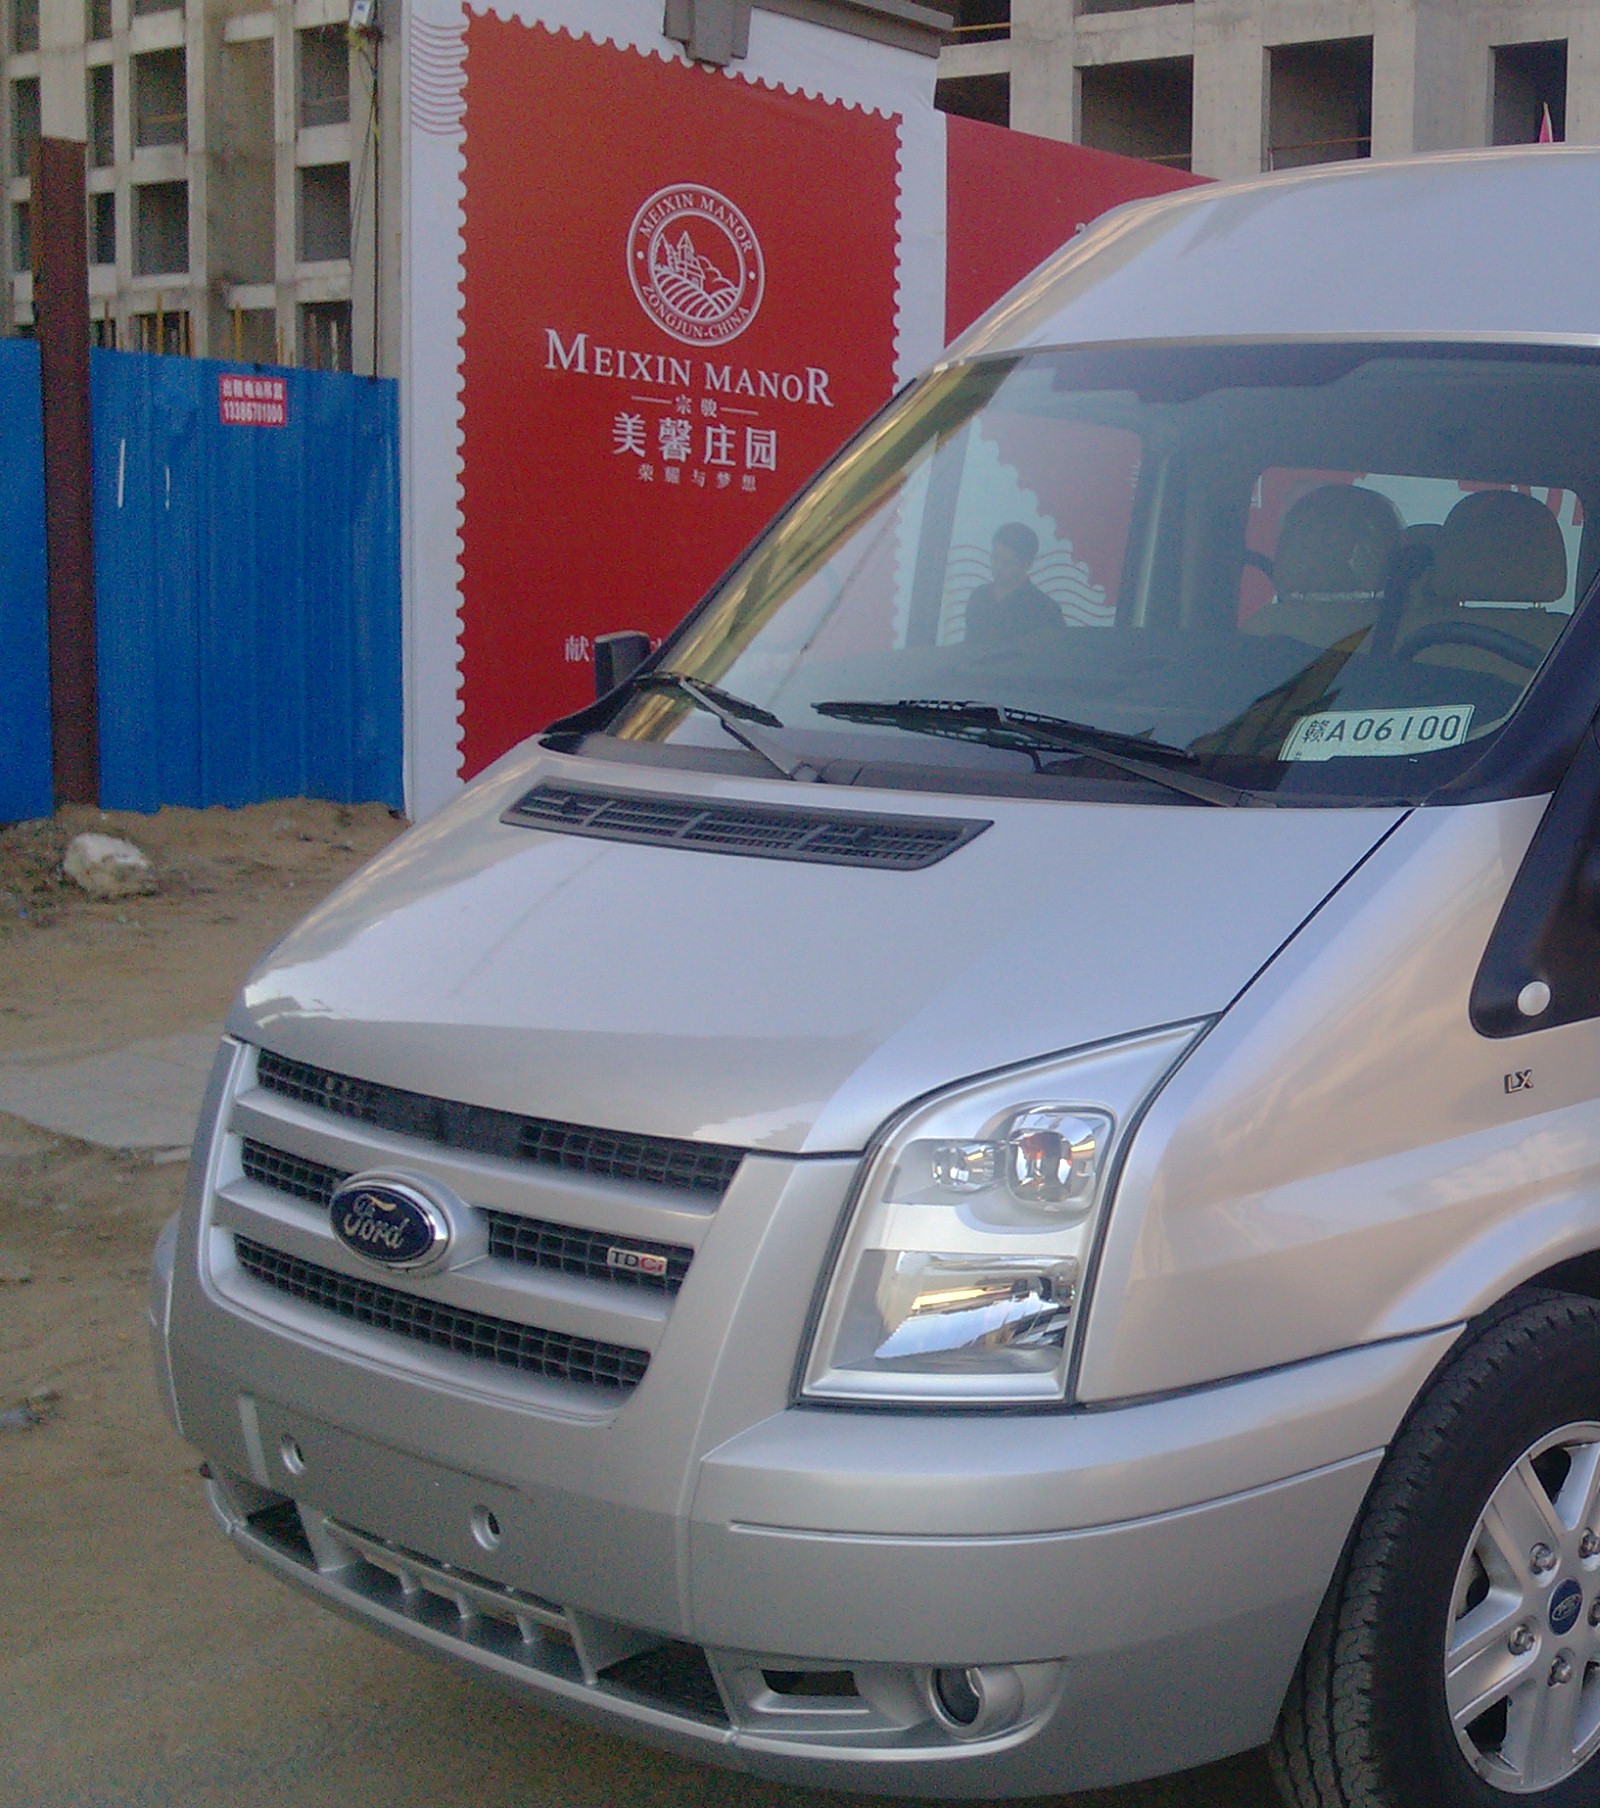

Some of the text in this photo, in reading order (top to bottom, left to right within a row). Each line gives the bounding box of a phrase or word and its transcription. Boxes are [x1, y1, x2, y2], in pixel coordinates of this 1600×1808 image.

[639, 193, 753, 254] MEIXIN MANOR
[544, 328, 834, 407] MEIXIN MANOR
[612, 411, 777, 472] 美馨庄园
[637, 462, 757, 493] 荣耀与梦想
[1302, 714, 1462, 744] 赣A06100
[1503, 1069, 1535, 1095] LX
[342, 1192, 412, 1250] Ford
[610, 1249, 665, 1274] TDCi
